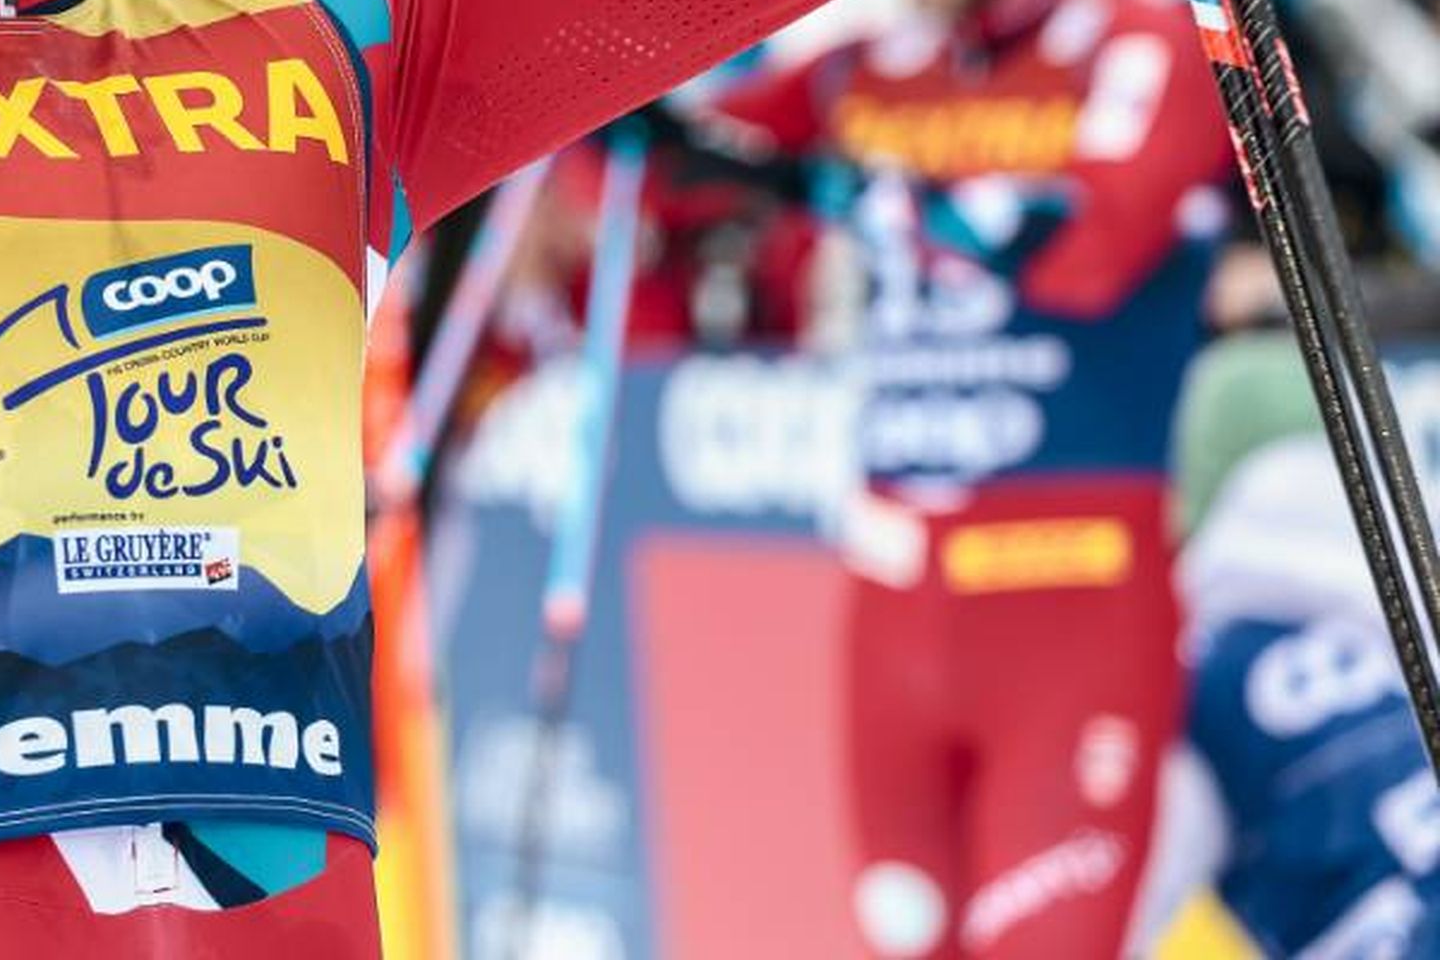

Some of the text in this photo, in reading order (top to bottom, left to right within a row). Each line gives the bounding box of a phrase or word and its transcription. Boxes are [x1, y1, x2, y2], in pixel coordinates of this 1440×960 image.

[102, 258, 237, 313] coop
[62, 536, 90, 564] LE
[69, 564, 197, 580] SWITZERLAND
